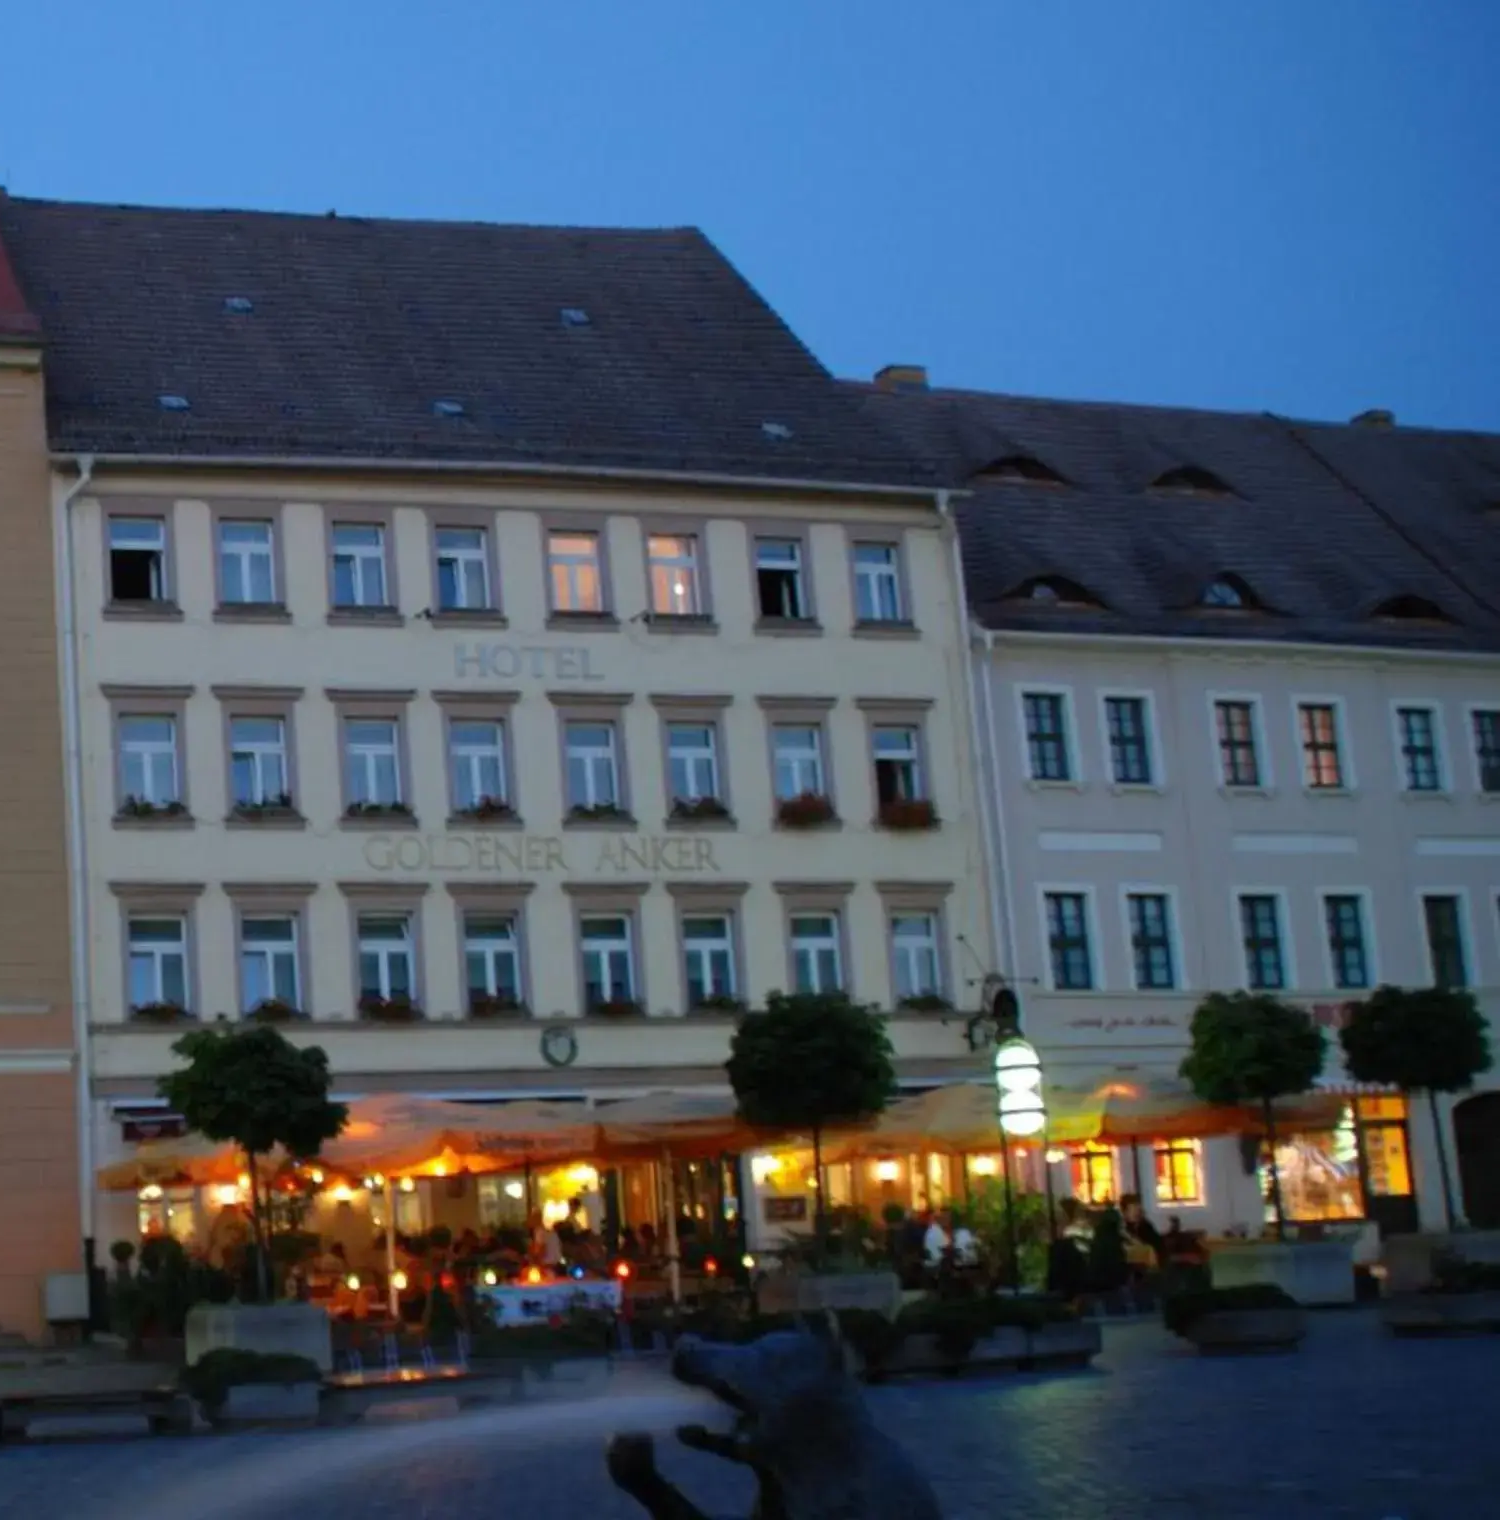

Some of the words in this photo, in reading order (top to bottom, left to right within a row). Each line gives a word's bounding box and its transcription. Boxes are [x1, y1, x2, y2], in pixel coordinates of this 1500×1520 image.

[454, 643, 605, 681] HOTEL
[363, 833, 569, 872] GOLDENER
[596, 835, 721, 873] ANKER
